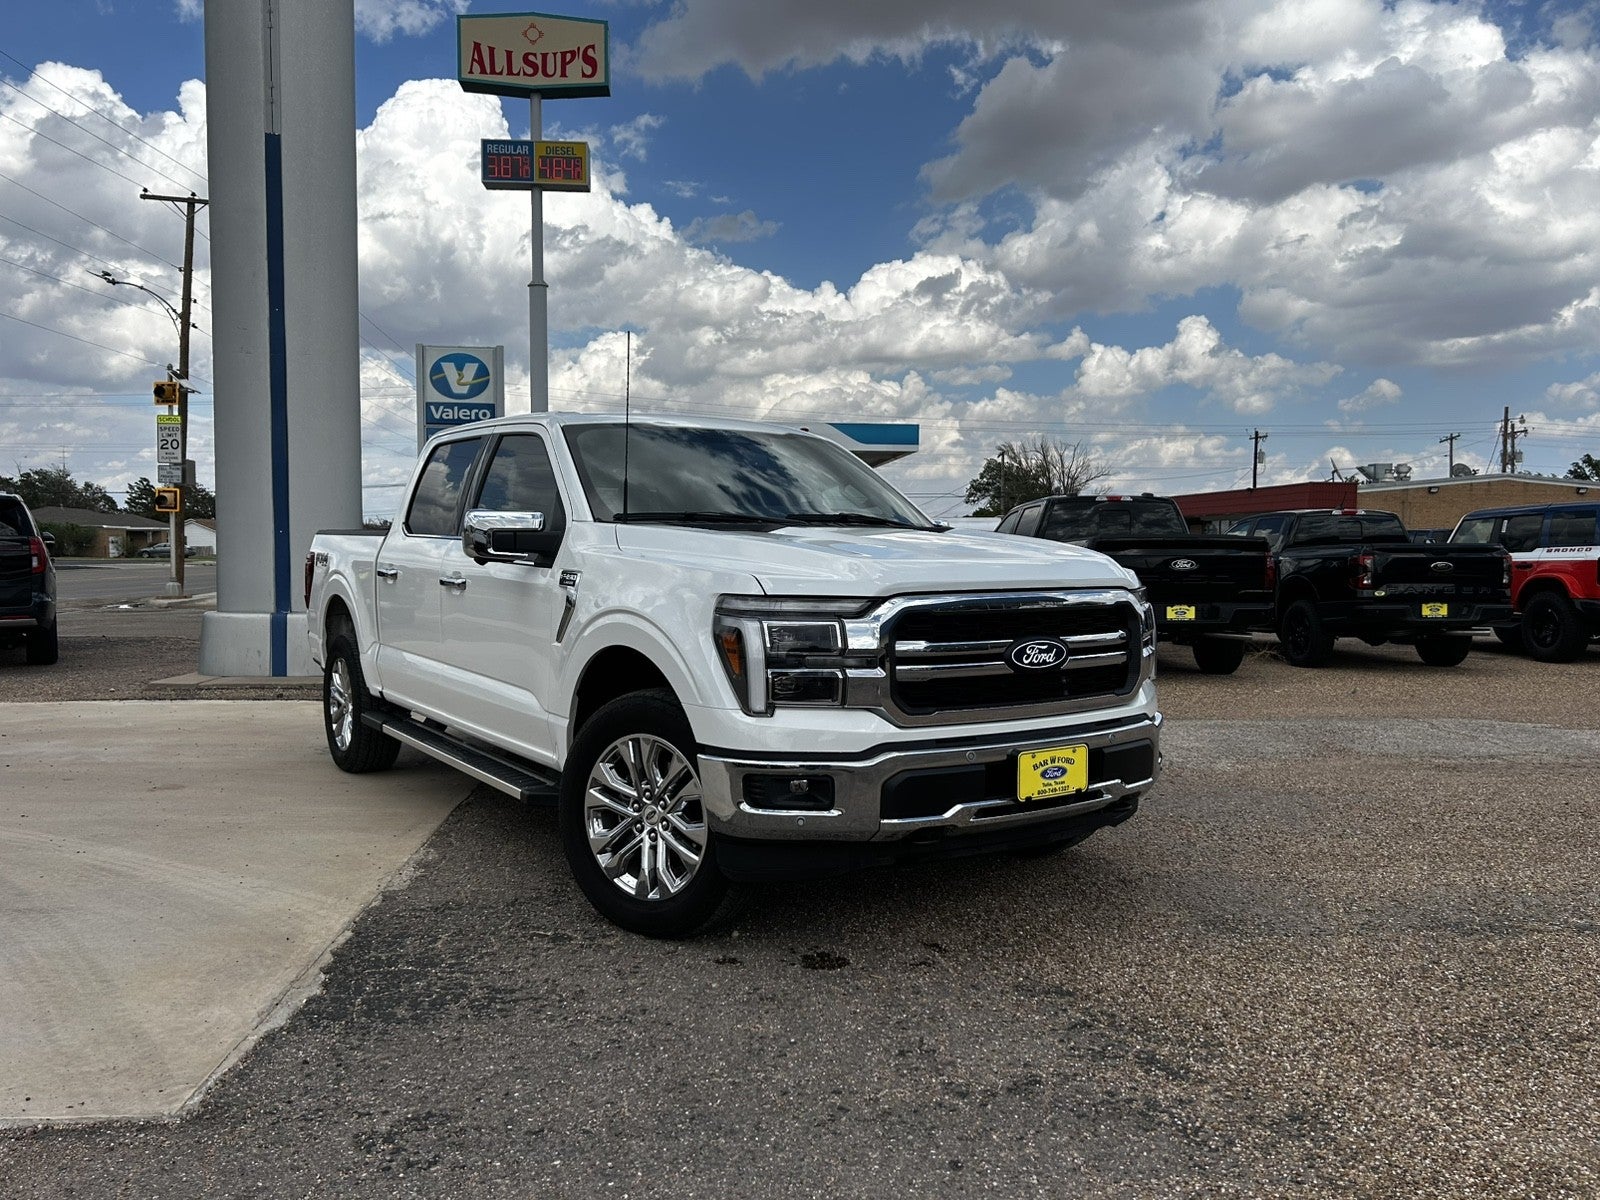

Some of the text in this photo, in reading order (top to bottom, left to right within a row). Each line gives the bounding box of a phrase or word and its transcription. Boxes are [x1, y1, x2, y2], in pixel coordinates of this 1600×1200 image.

[468, 41, 598, 78] ALLSUP'S
[487, 144, 529, 155] REGULAR
[545, 146, 577, 156] DIESEL
[429, 405, 491, 420] Valero
[160, 439, 180, 450] 20
[1386, 585, 1491, 594] RANGER
[1022, 644, 1057, 664] Ford
[1032, 758, 1049, 771] BAR
[1057, 756, 1075, 766] FORD
[1045, 767, 1063, 778] Ford
